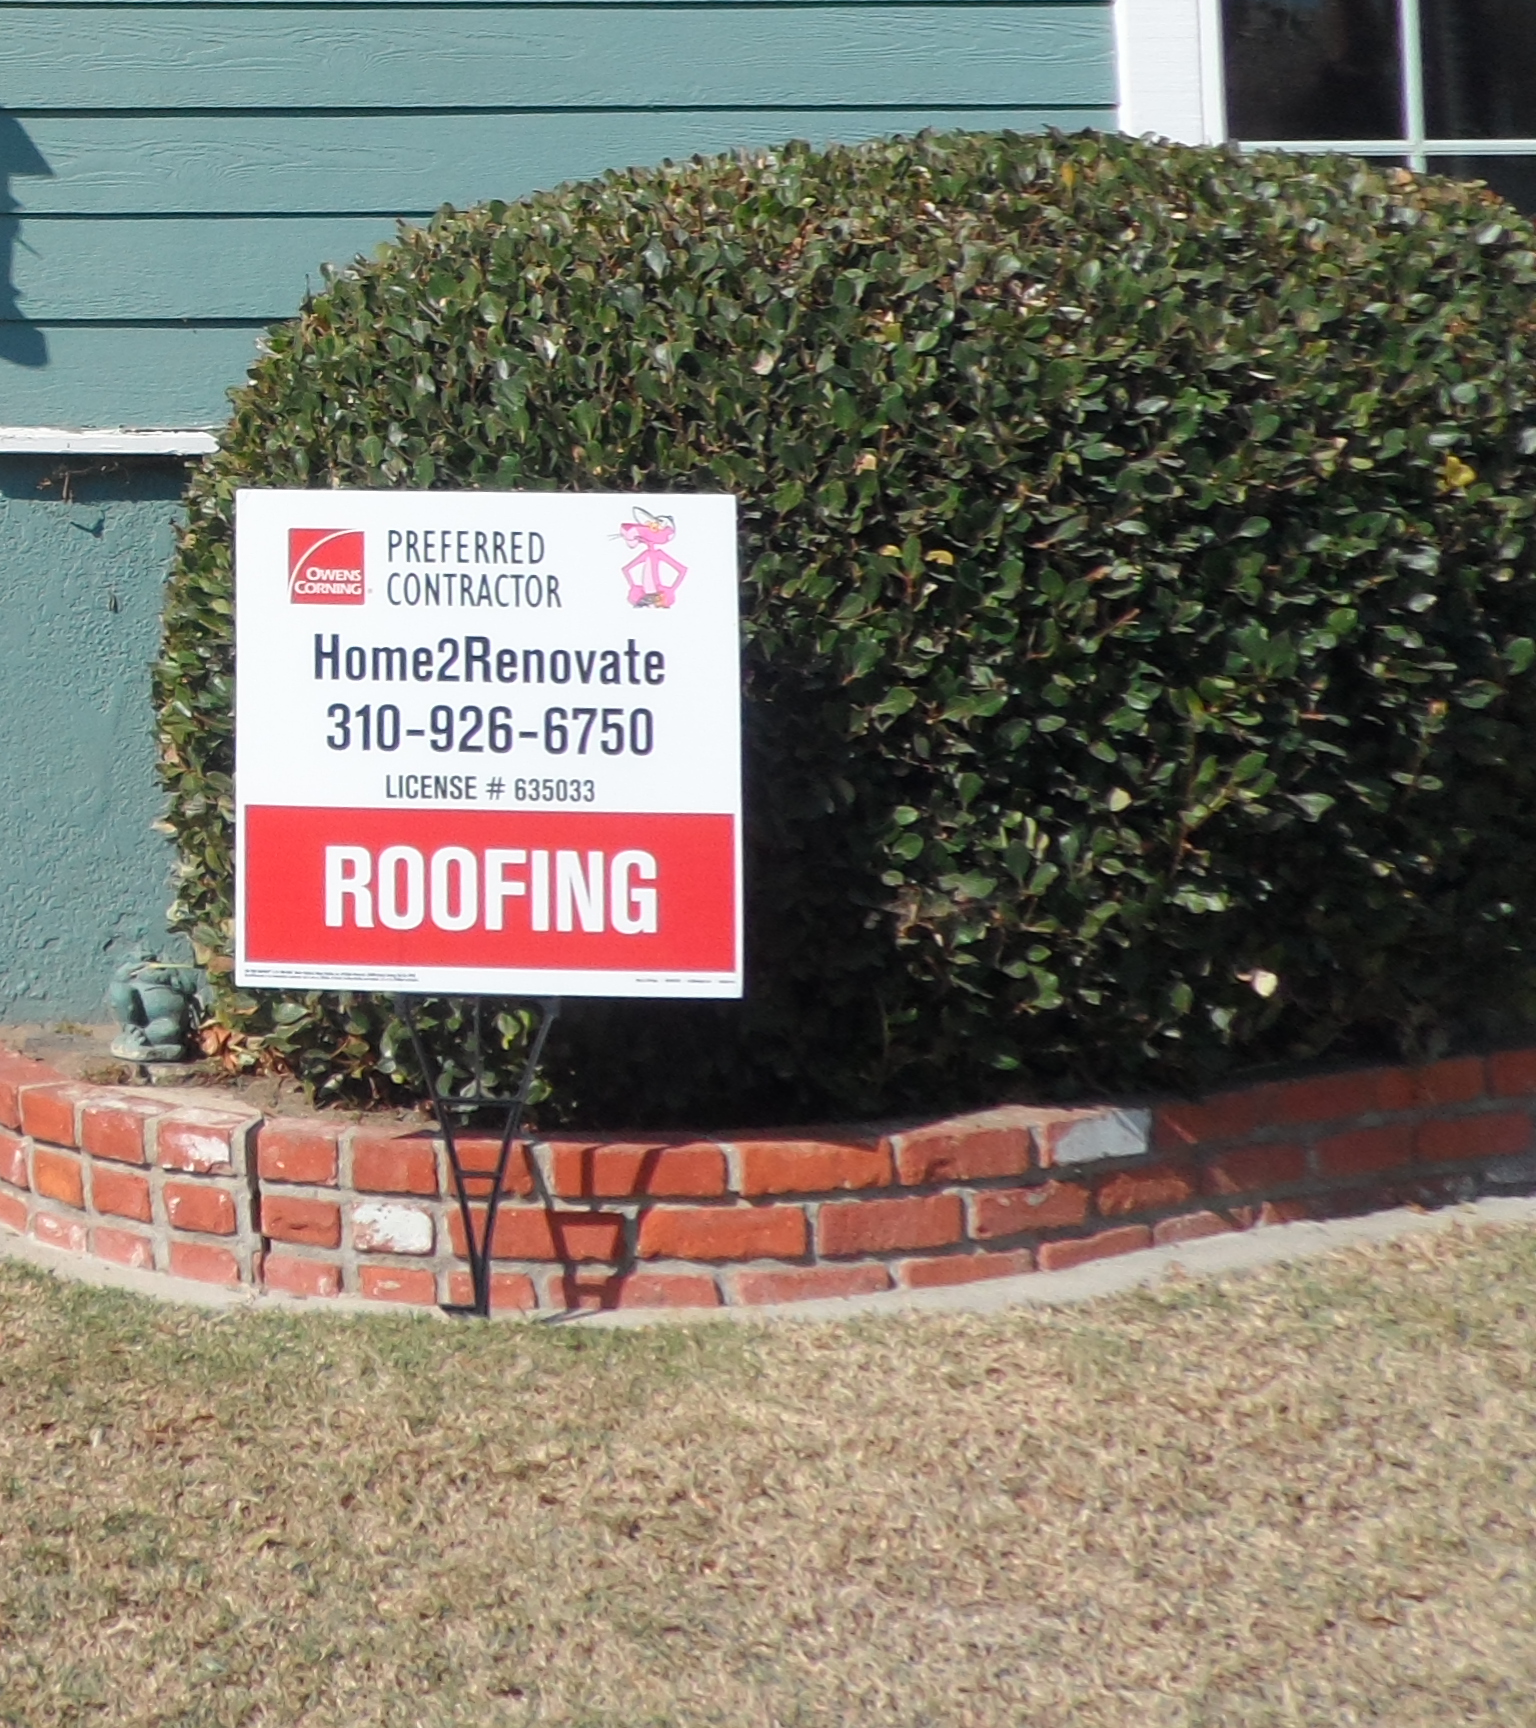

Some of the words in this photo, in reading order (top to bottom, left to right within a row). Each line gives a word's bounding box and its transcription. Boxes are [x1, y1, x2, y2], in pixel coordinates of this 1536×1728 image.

[387, 529, 545, 565] PREFERRED
[294, 580, 362, 595] CORNING
[305, 566, 362, 581] OWENS
[387, 573, 562, 608] CONTRACTOR
[314, 633, 665, 685] Home2Renovate
[326, 703, 654, 756] 310-926-6750
[385, 775, 477, 800] LICENSE
[486, 777, 506, 800] #
[514, 779, 595, 803] 635033
[325, 845, 658, 935] ROOFING
